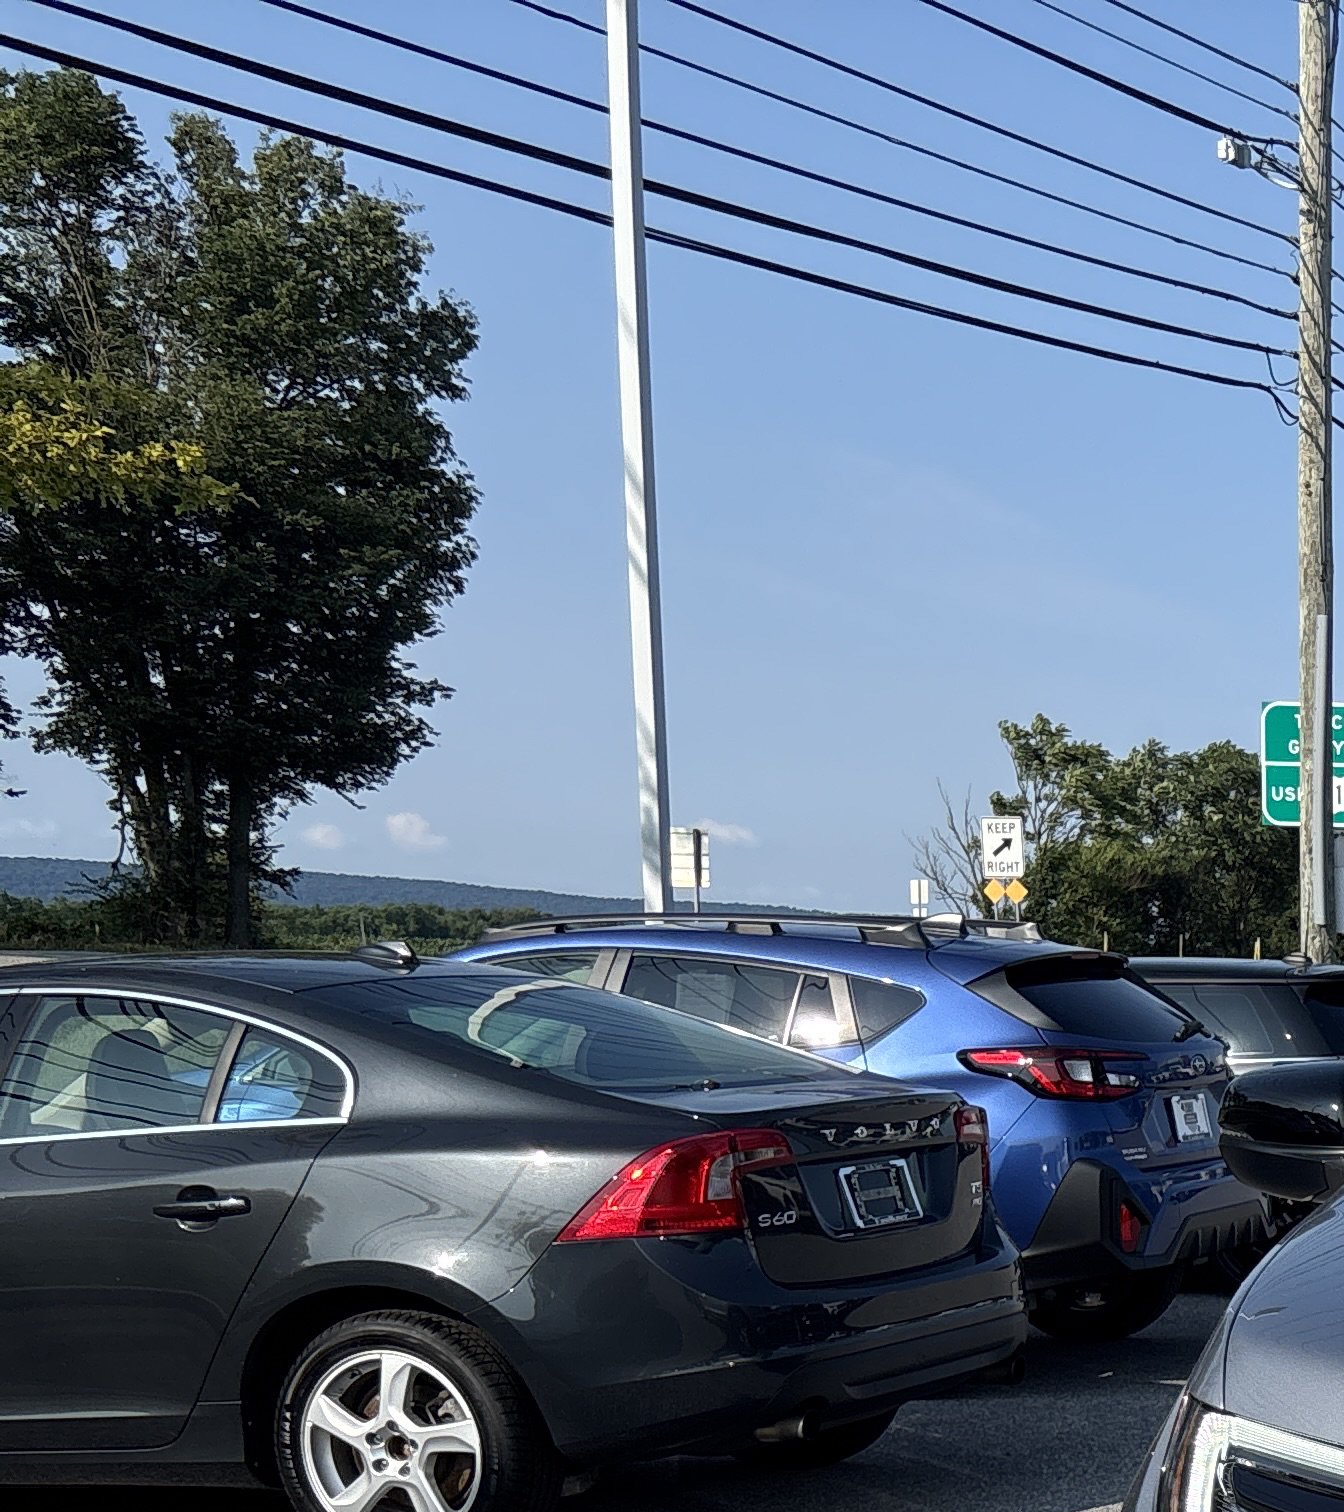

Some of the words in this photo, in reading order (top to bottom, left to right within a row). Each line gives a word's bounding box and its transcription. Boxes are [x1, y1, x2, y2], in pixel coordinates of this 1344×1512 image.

[987, 822, 1016, 834] KEEP
[987, 861, 1020, 873] RIGHT
[820, 1117, 942, 1142] VOLVO
[758, 1210, 797, 1227] S60
